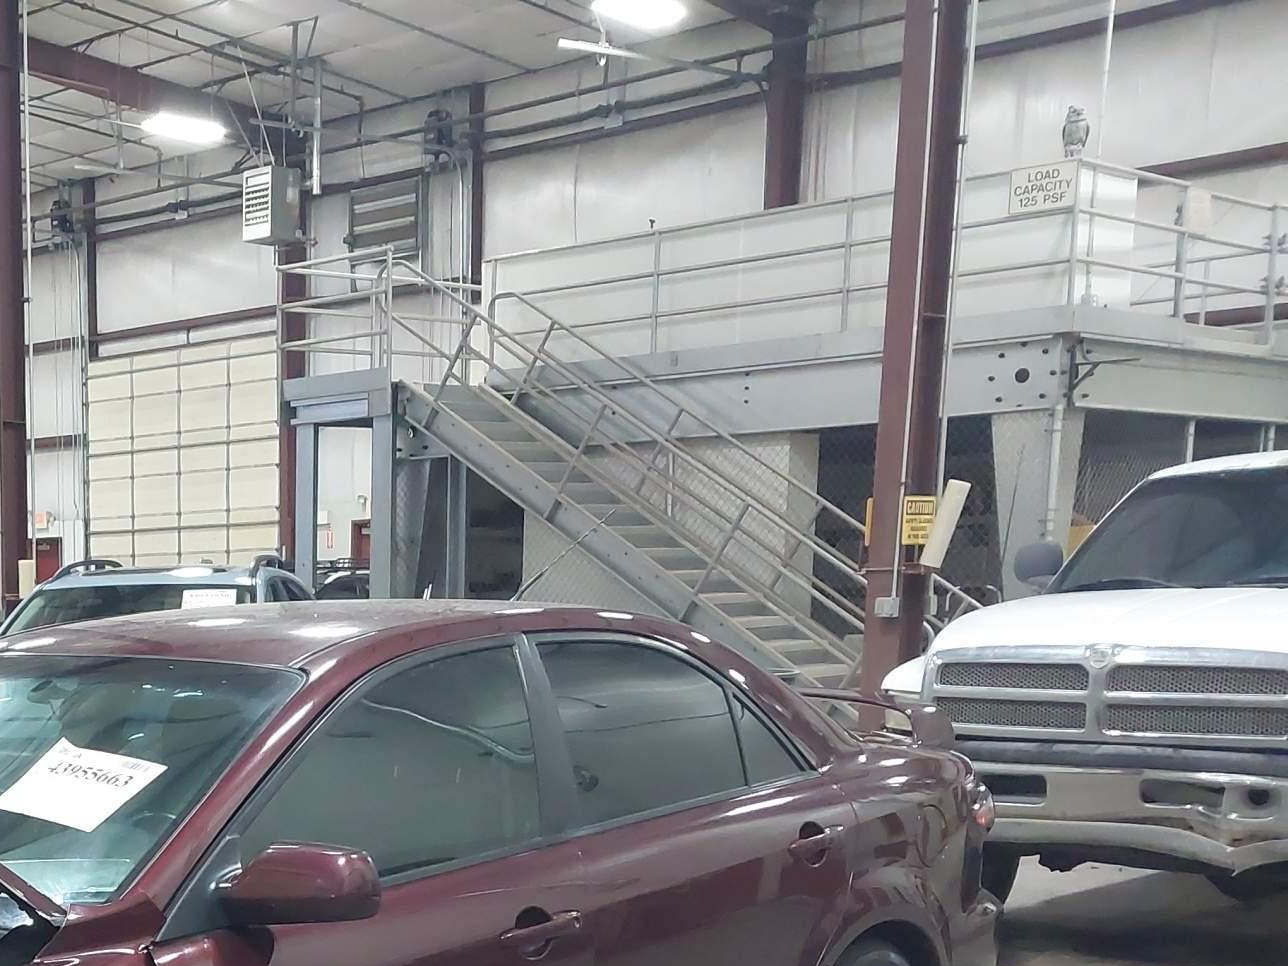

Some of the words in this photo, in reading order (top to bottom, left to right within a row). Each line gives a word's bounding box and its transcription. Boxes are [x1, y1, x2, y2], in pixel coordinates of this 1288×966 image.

[1027, 168, 1061, 183] LOAD
[1014, 177, 1073, 197] CAPACITY
[1018, 195, 1038, 209] 125
[1043, 190, 1067, 205] PSF
[47, 761, 134, 787] 43955663
